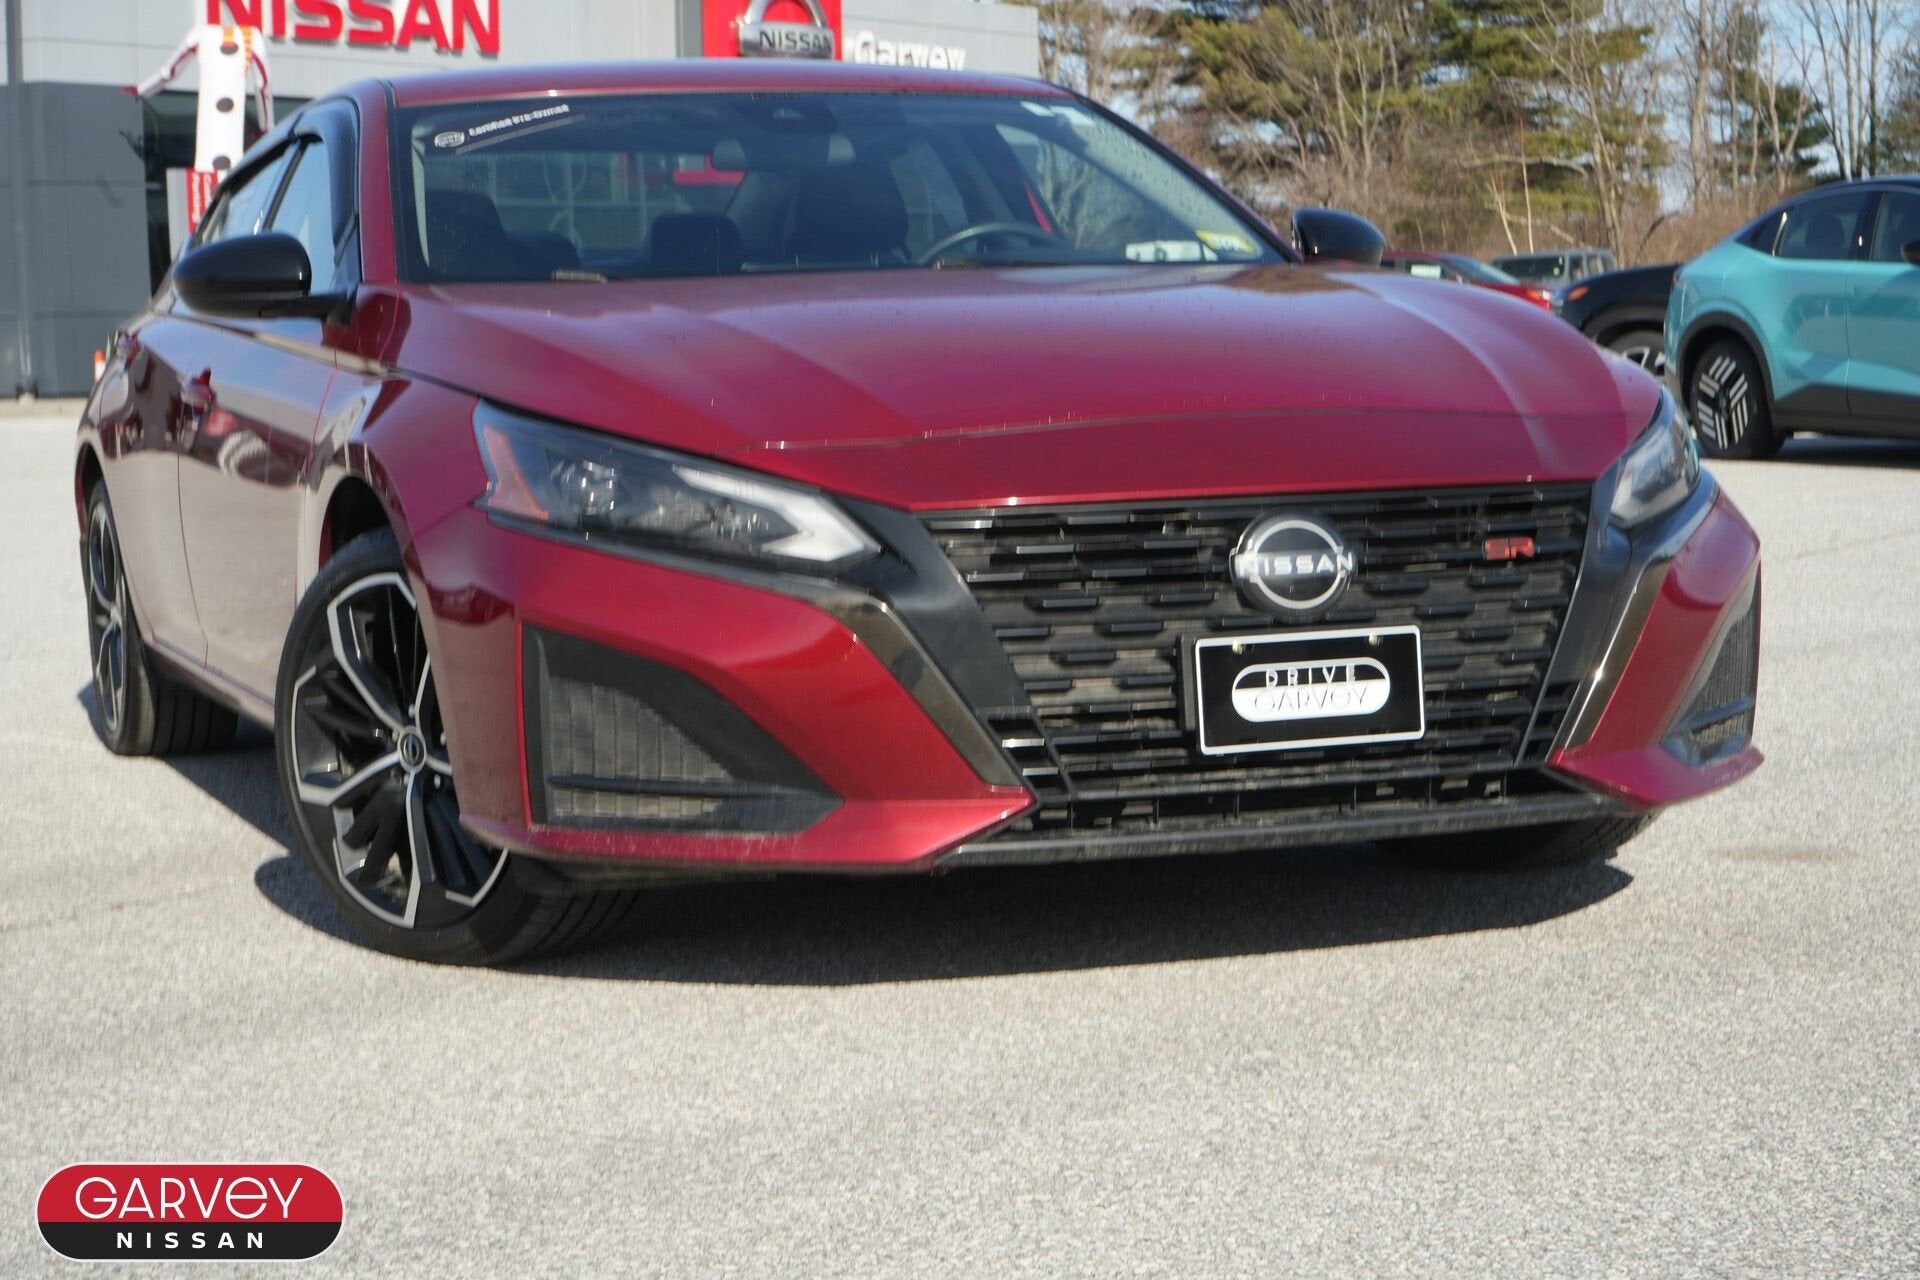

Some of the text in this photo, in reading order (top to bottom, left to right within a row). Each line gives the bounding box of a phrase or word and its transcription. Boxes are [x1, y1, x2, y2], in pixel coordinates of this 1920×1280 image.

[206, 0, 499, 54] NISSAN
[758, 29, 832, 52] NISSAN
[854, 30, 966, 71] Garvey
[1235, 551, 1353, 578] NISSAN
[1265, 663, 1356, 688] DRIVE
